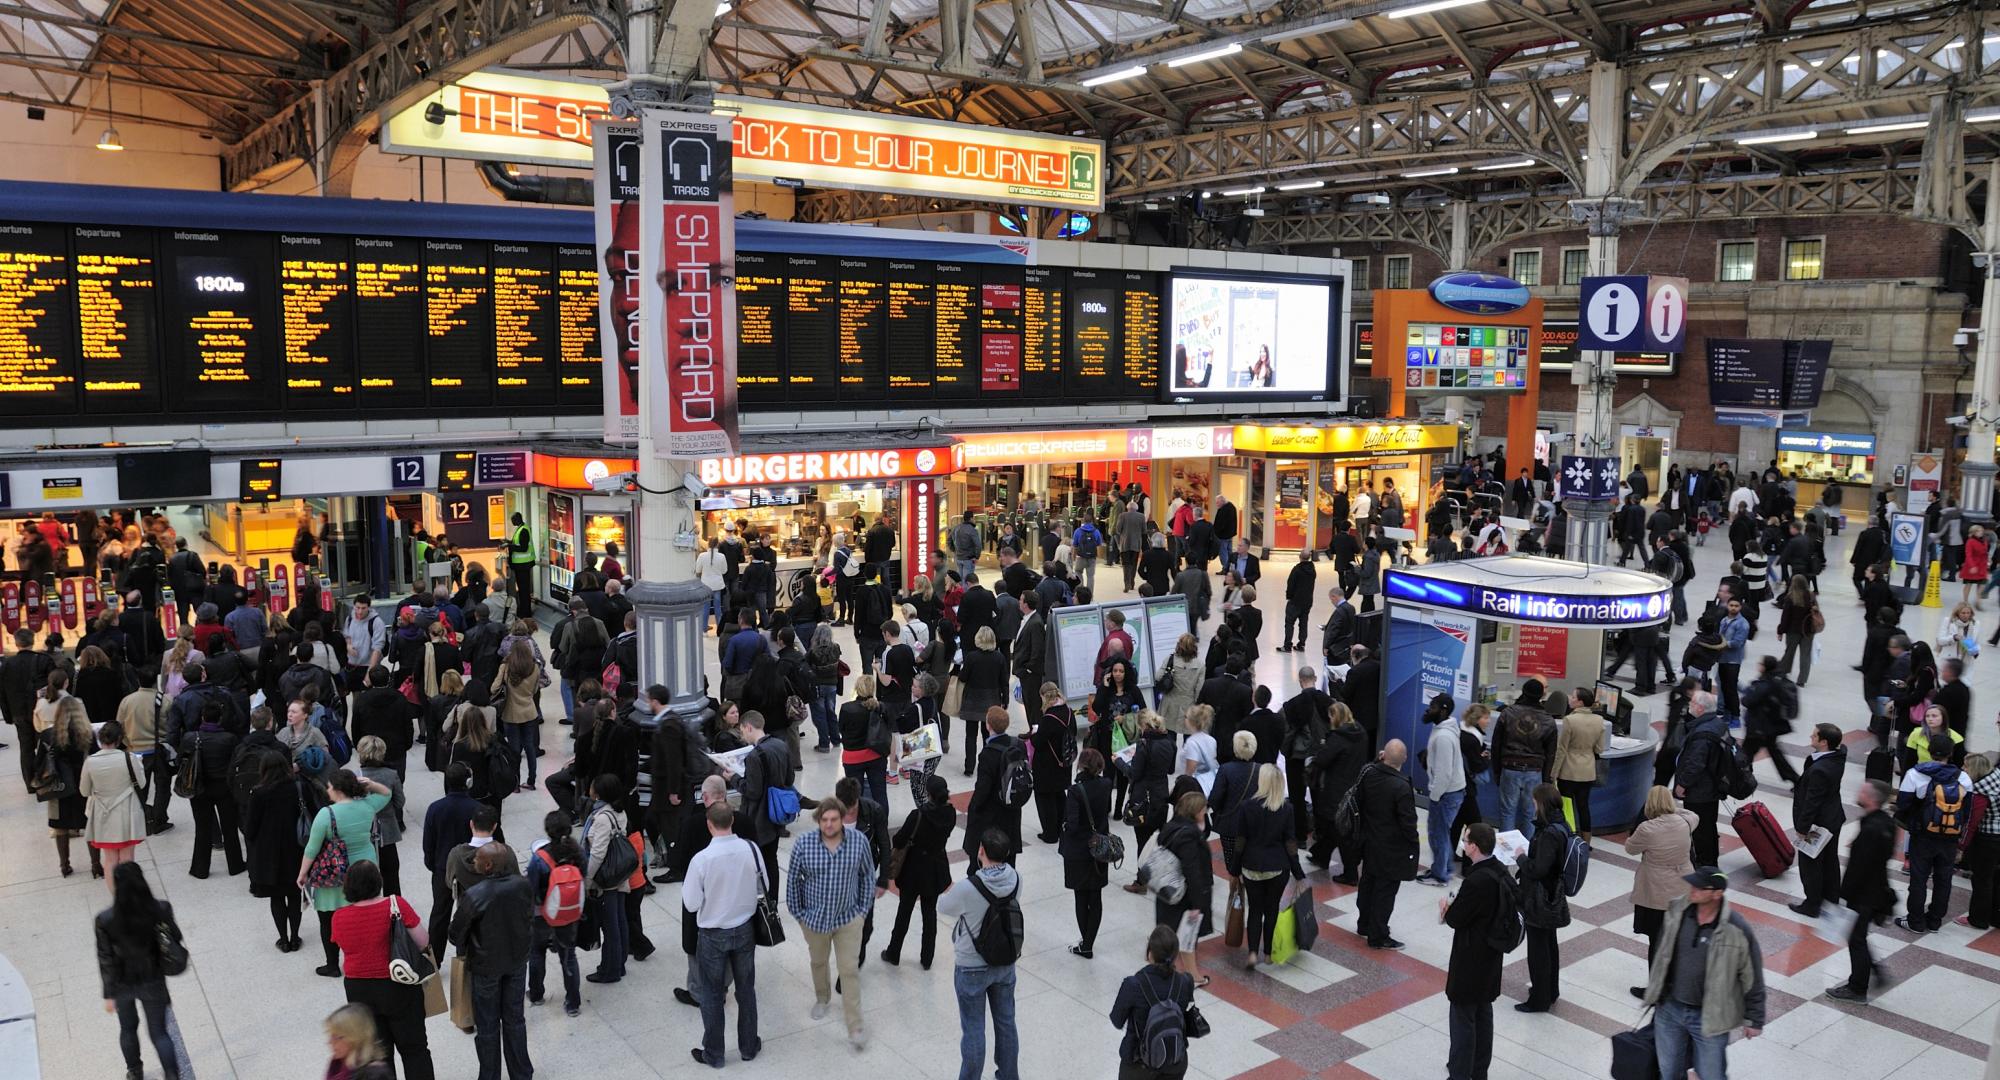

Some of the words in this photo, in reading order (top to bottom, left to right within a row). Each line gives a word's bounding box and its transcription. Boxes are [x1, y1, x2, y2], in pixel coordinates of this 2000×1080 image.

[464, 92, 541, 135] THE
[801, 128, 841, 163] TO
[853, 133, 934, 174] YOUR
[943, 143, 1067, 186] JOURNEY
[672, 185, 710, 196] TRACKS
[76, 227, 121, 238] Departures
[174, 231, 219, 241] Information
[281, 234, 321, 245] Departures
[355, 238, 394, 248] Departures
[426, 240, 463, 251] Departures
[494, 244, 529, 253] Departures
[559, 247, 592, 256] Departures
[675, 213, 716, 423] SHEPPARD
[686, 433, 726, 441] SOUNDTRACK
[1130, 435, 1149, 454] 13
[1155, 437, 1192, 448] Tickets
[1216, 433, 1233, 450] 14
[1363, 430, 1392, 449] Upper
[1394, 427, 1424, 444] Crust
[396, 461, 421, 482] 12
[701, 453, 824, 485] BURGER
[828, 450, 901, 479] KING
[449, 502, 470, 520] 12
[1481, 590, 1521, 615] Rail
[1527, 595, 1642, 620] information
[1543, 627, 1566, 635] Airport
[1421, 660, 1454, 676] Victoria
[1420, 672, 1452, 688] Station
